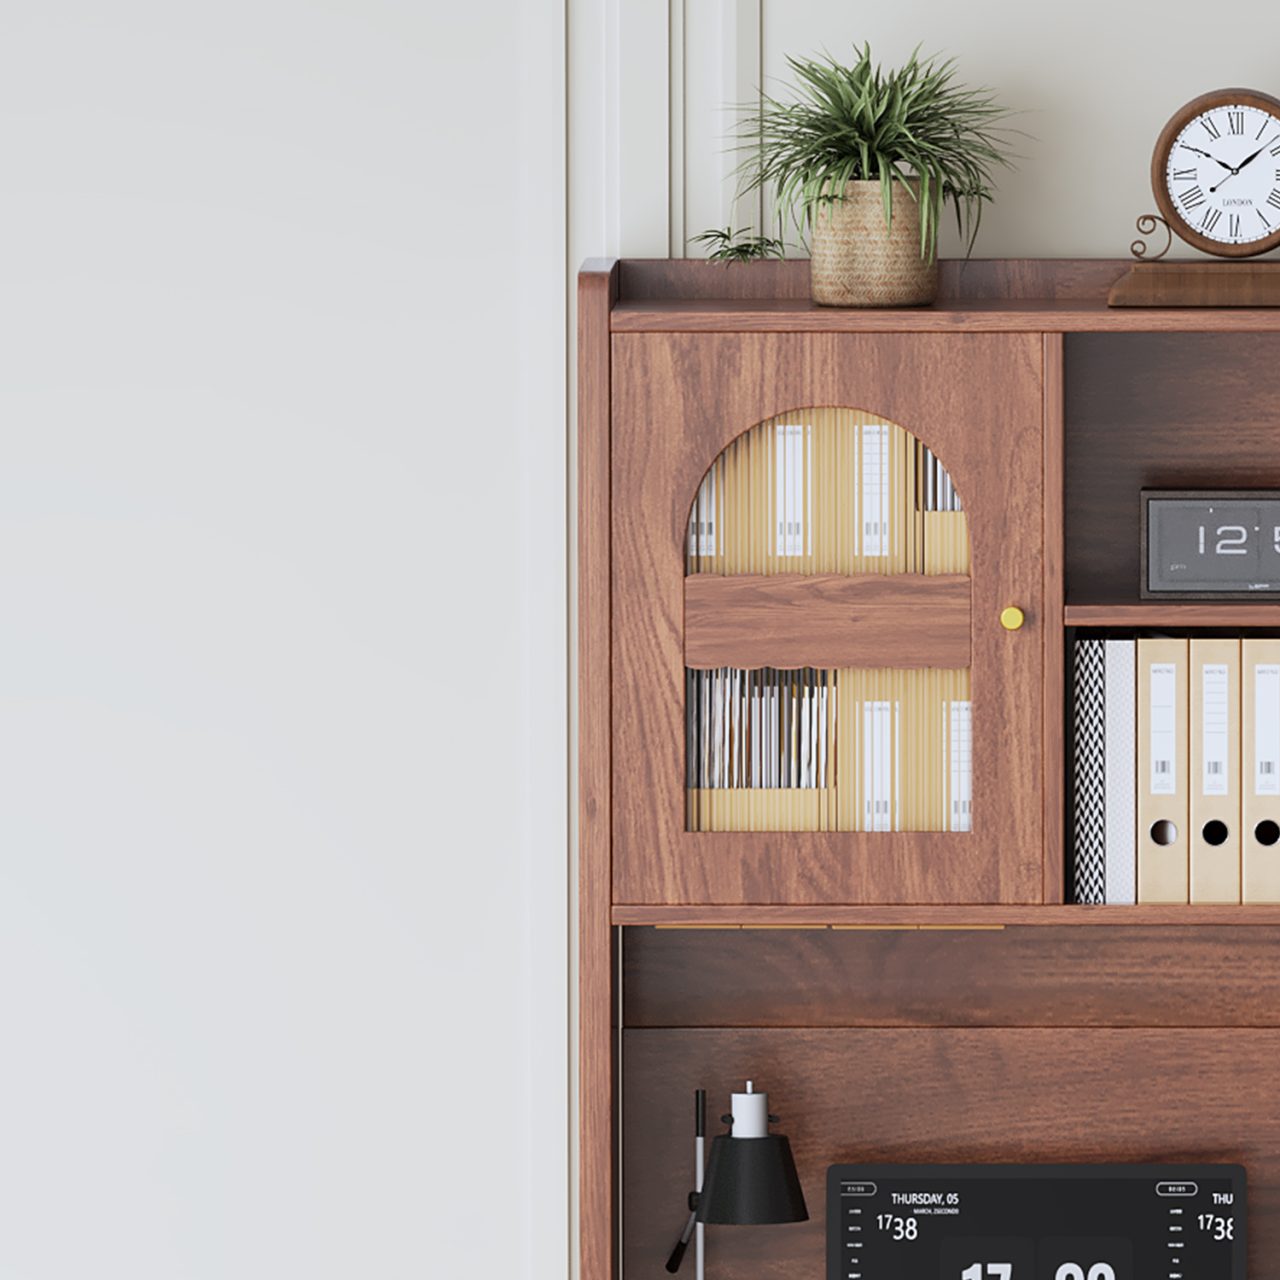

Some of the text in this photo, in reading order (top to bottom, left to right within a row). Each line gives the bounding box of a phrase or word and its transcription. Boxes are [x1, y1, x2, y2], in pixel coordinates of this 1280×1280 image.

[1222, 198, 1254, 207] LONDON
[891, 1193, 960, 1206] THURSDAY, 05
[1212, 1193, 1234, 1205] THU
